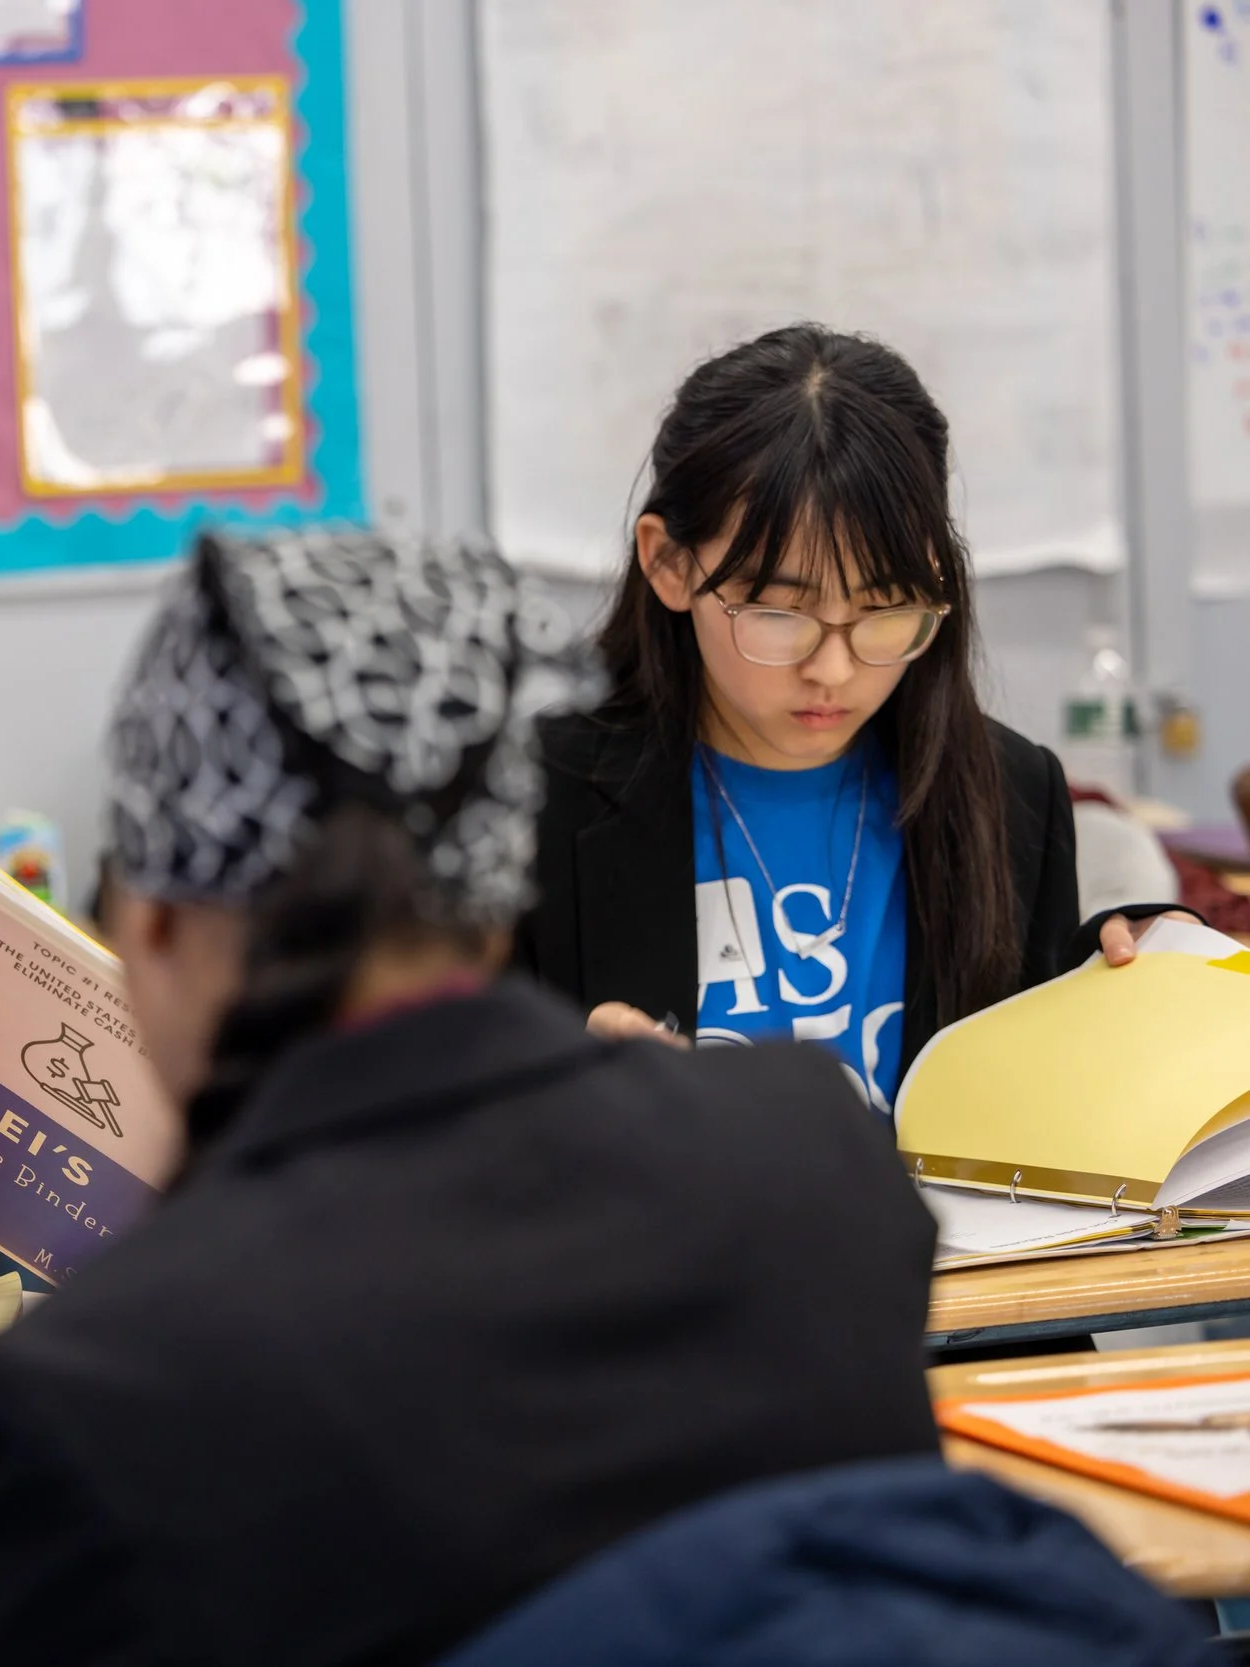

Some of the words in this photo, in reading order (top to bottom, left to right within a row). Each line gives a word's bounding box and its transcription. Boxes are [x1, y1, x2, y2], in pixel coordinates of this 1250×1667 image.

[29, 961, 82, 1000] UNITED
[86, 1000, 137, 1039] STATES
[33, 941, 77, 975] TOPIC
[81, 976, 100, 991] #1
[13, 962, 90, 1017] ELIMINATE
[93, 1017, 134, 1047] CASH
[13, 1164, 114, 1238] Binder
